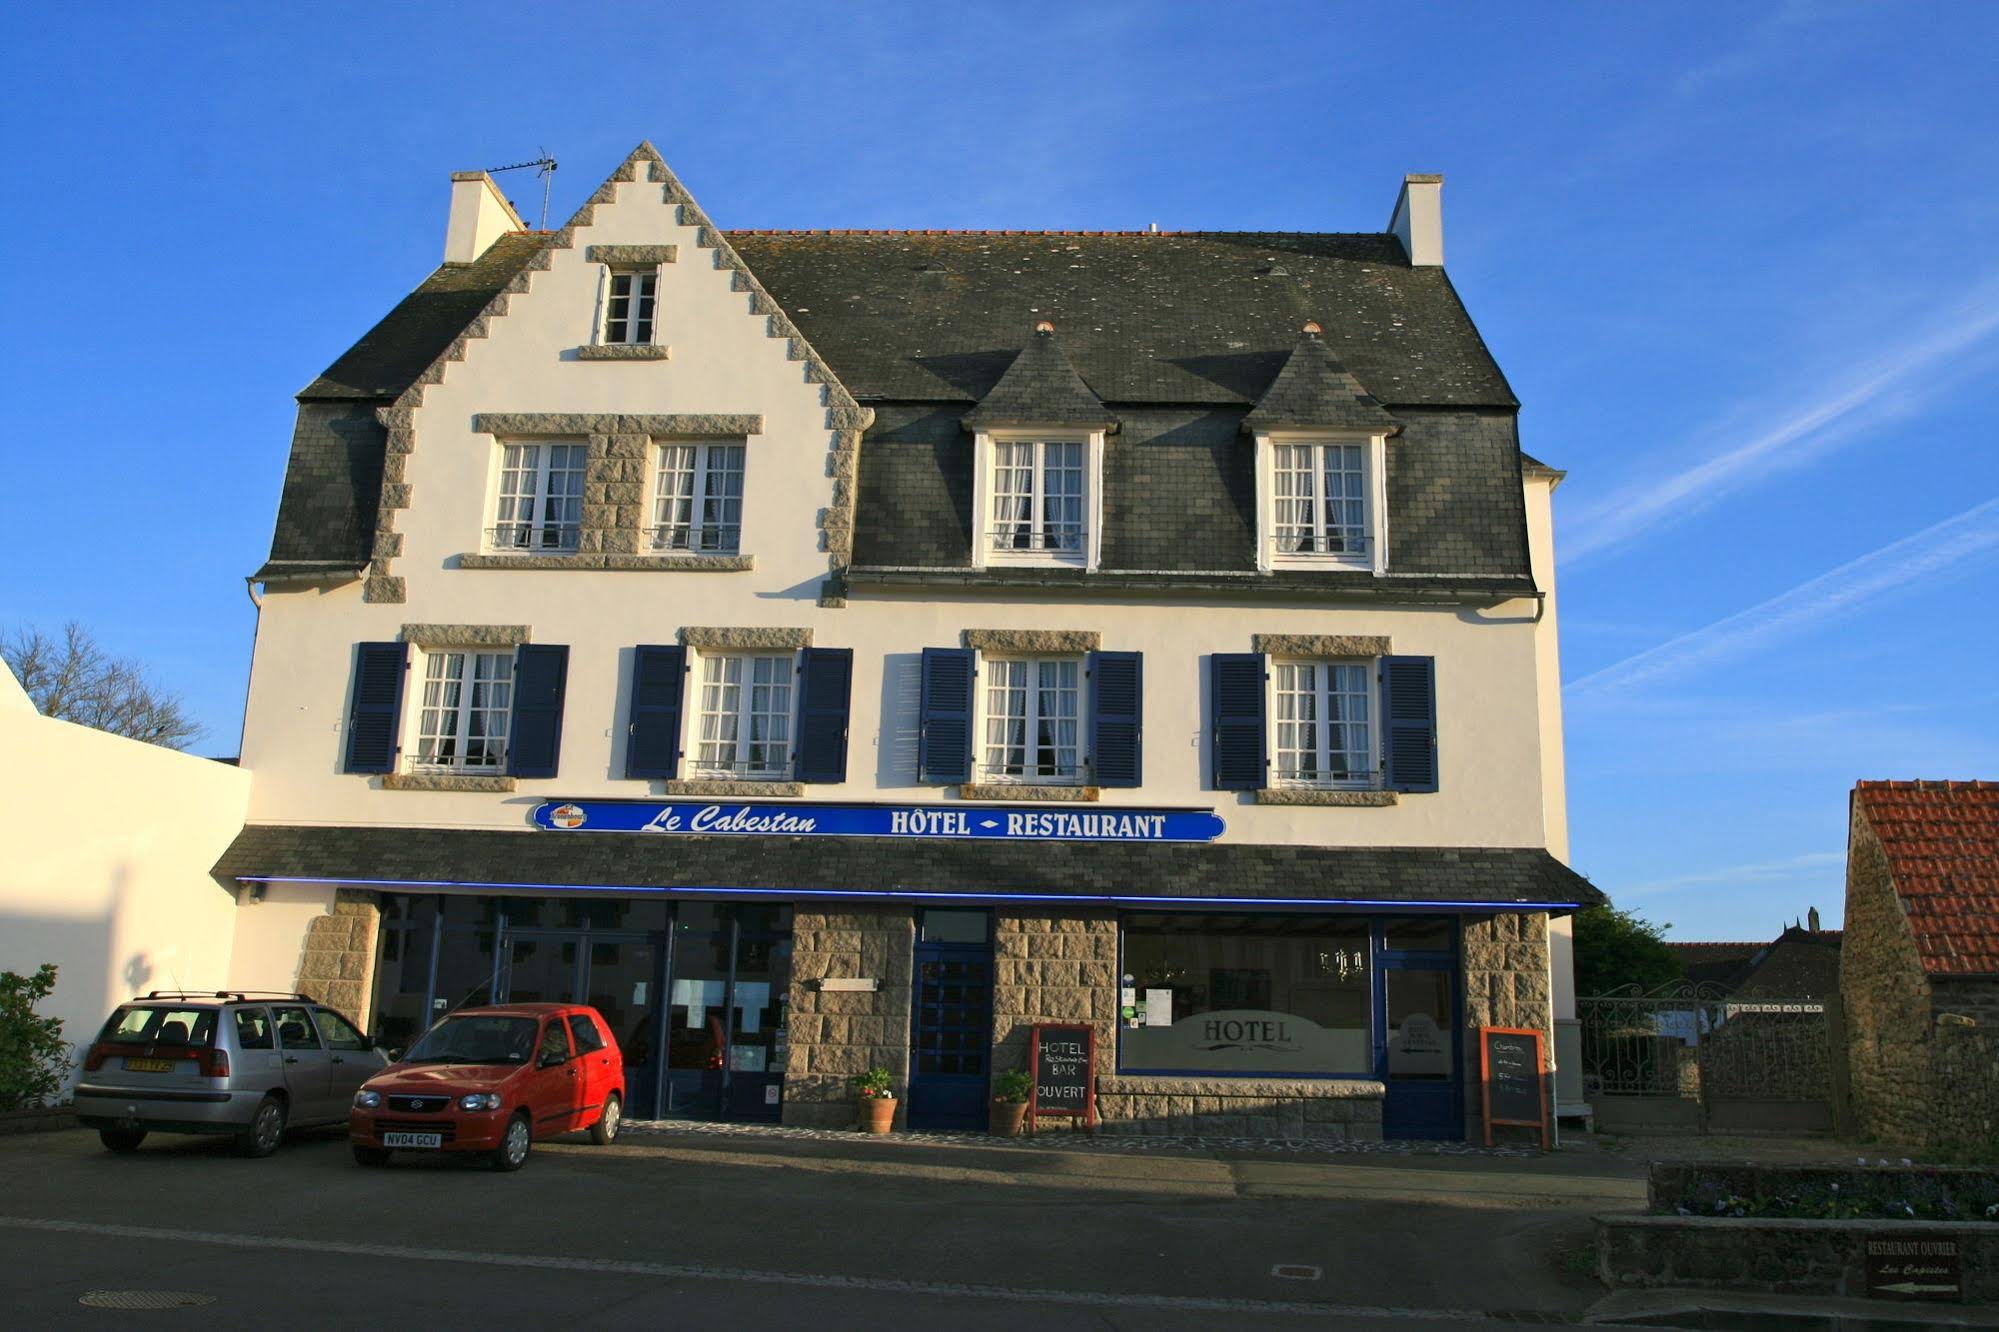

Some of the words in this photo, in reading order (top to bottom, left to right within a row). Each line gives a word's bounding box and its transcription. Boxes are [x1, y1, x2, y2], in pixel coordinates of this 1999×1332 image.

[641, 806, 681, 831] Le
[690, 805, 815, 832] Cabestan
[890, 809, 970, 835] HÔTEL
[1007, 813, 1166, 838] RESTAURANT
[1201, 1020, 1291, 1041] HOTEL
[1038, 1042, 1085, 1055] HOTEL
[1052, 1064, 1077, 1076] BAR
[1037, 1086, 1085, 1098] OUVERT
[388, 1134, 414, 1145] NV04
[416, 1135, 437, 1146] GCU
[1868, 1240, 1919, 1256] RESTAURANT
